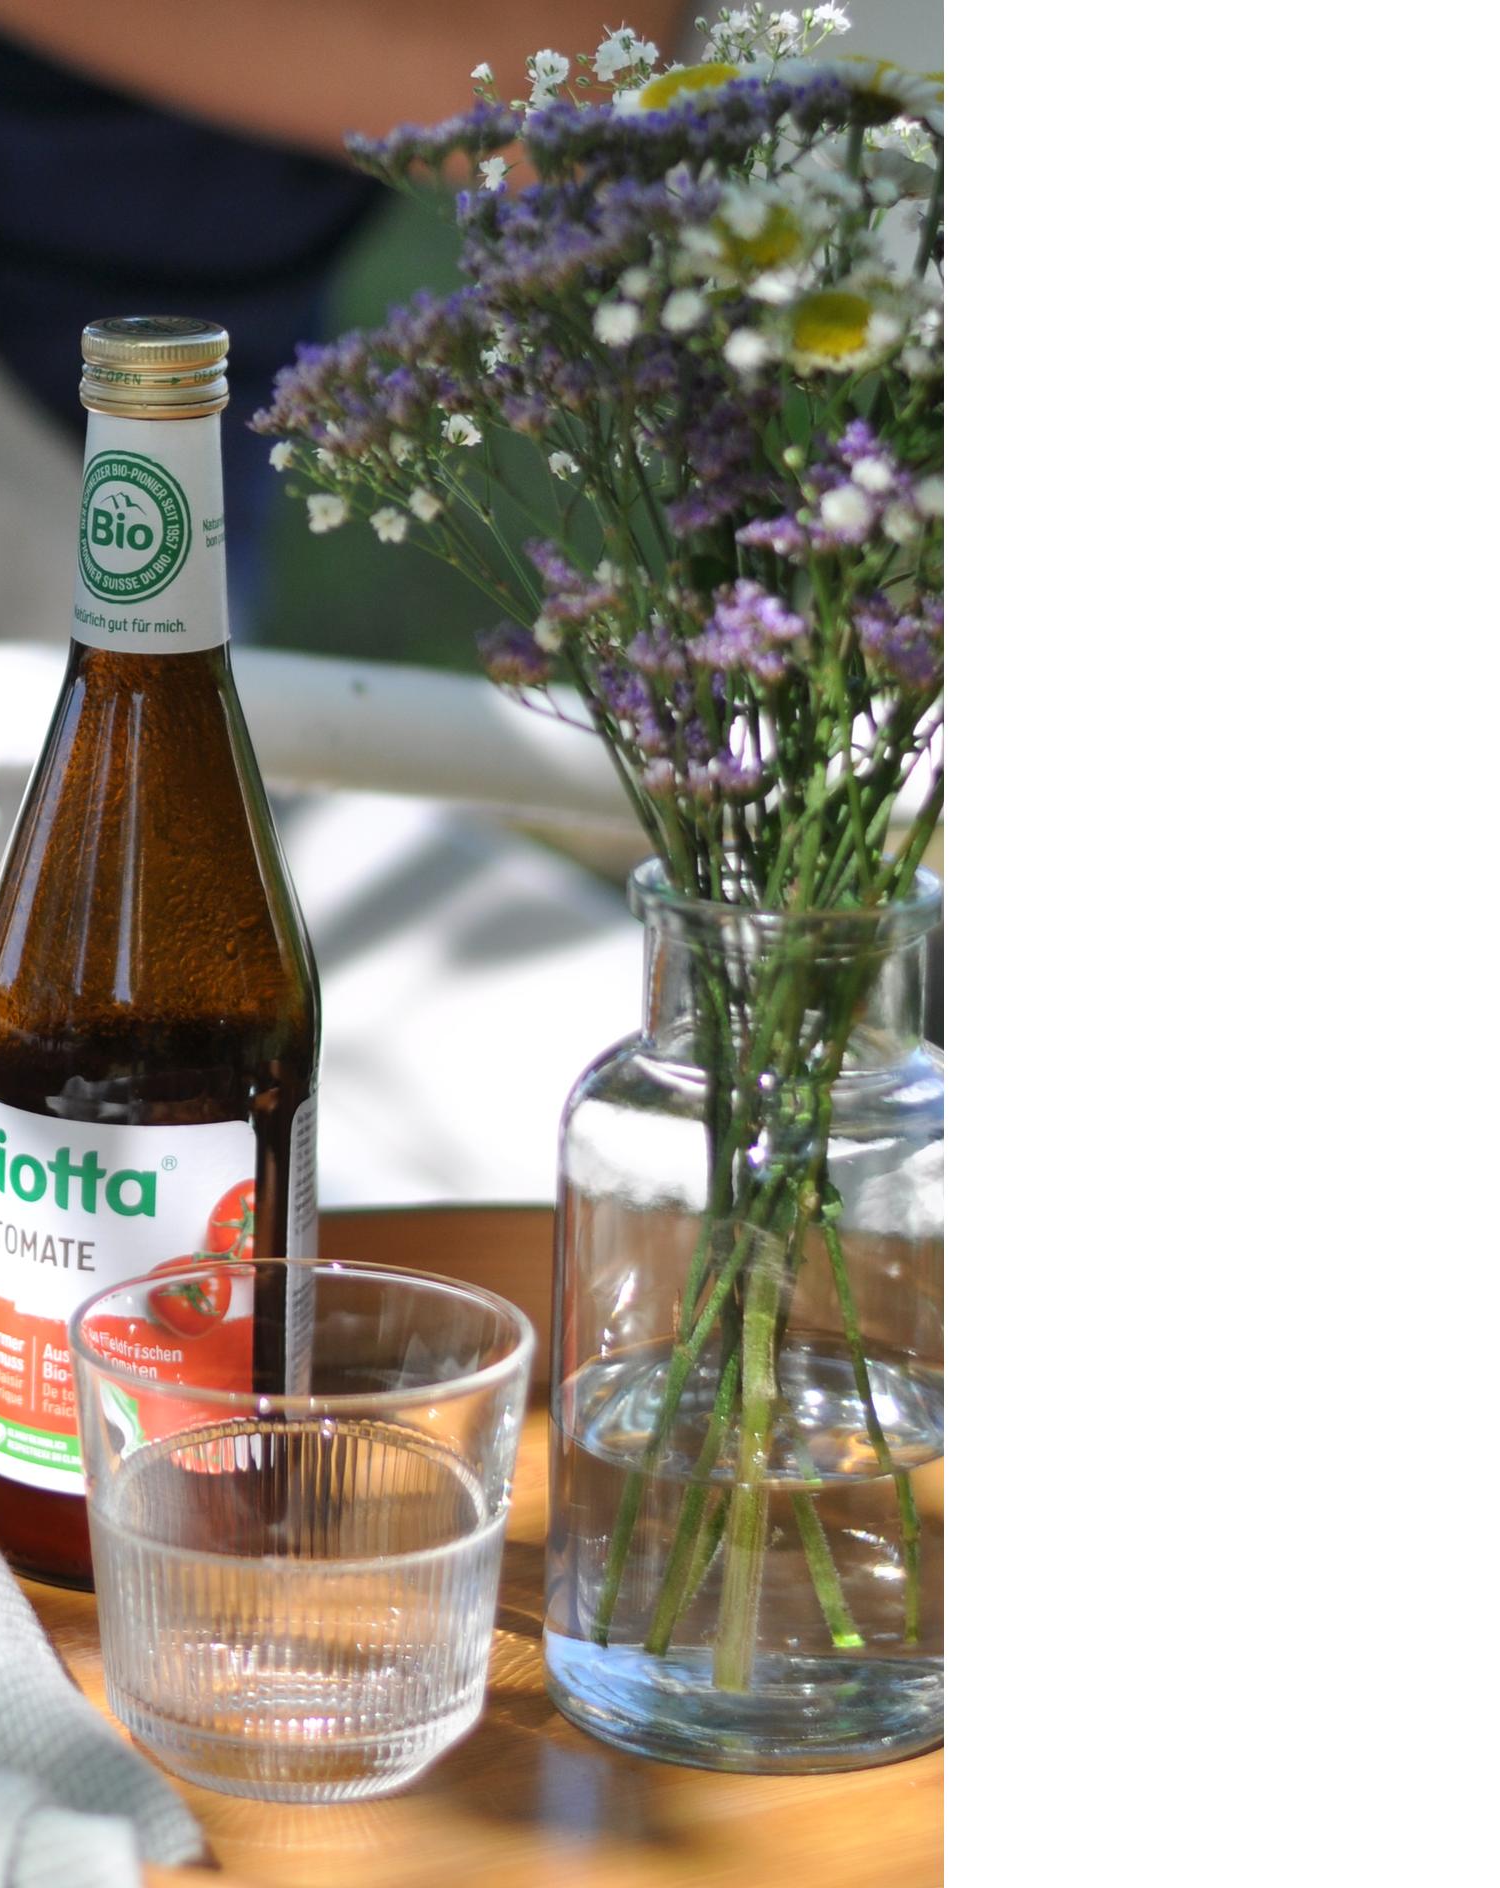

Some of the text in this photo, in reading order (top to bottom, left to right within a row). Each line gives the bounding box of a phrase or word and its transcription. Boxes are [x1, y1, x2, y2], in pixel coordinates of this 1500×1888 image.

[106, 371, 142, 386] OPEN
[111, 463, 168, 500] BIO-PIONIER
[161, 496, 179, 522] SEIT
[91, 507, 154, 551] Bio
[165, 523, 180, 550] 1957
[102, 575, 141, 591] SUISSE
[140, 568, 157, 585] DU
[152, 553, 172, 574] BIO
[108, 618, 128, 633] gut
[132, 618, 152, 633] für
[154, 618, 187, 633] mich.
[43, 1342, 71, 1363] Aus
[43, 1382, 59, 1399] De
